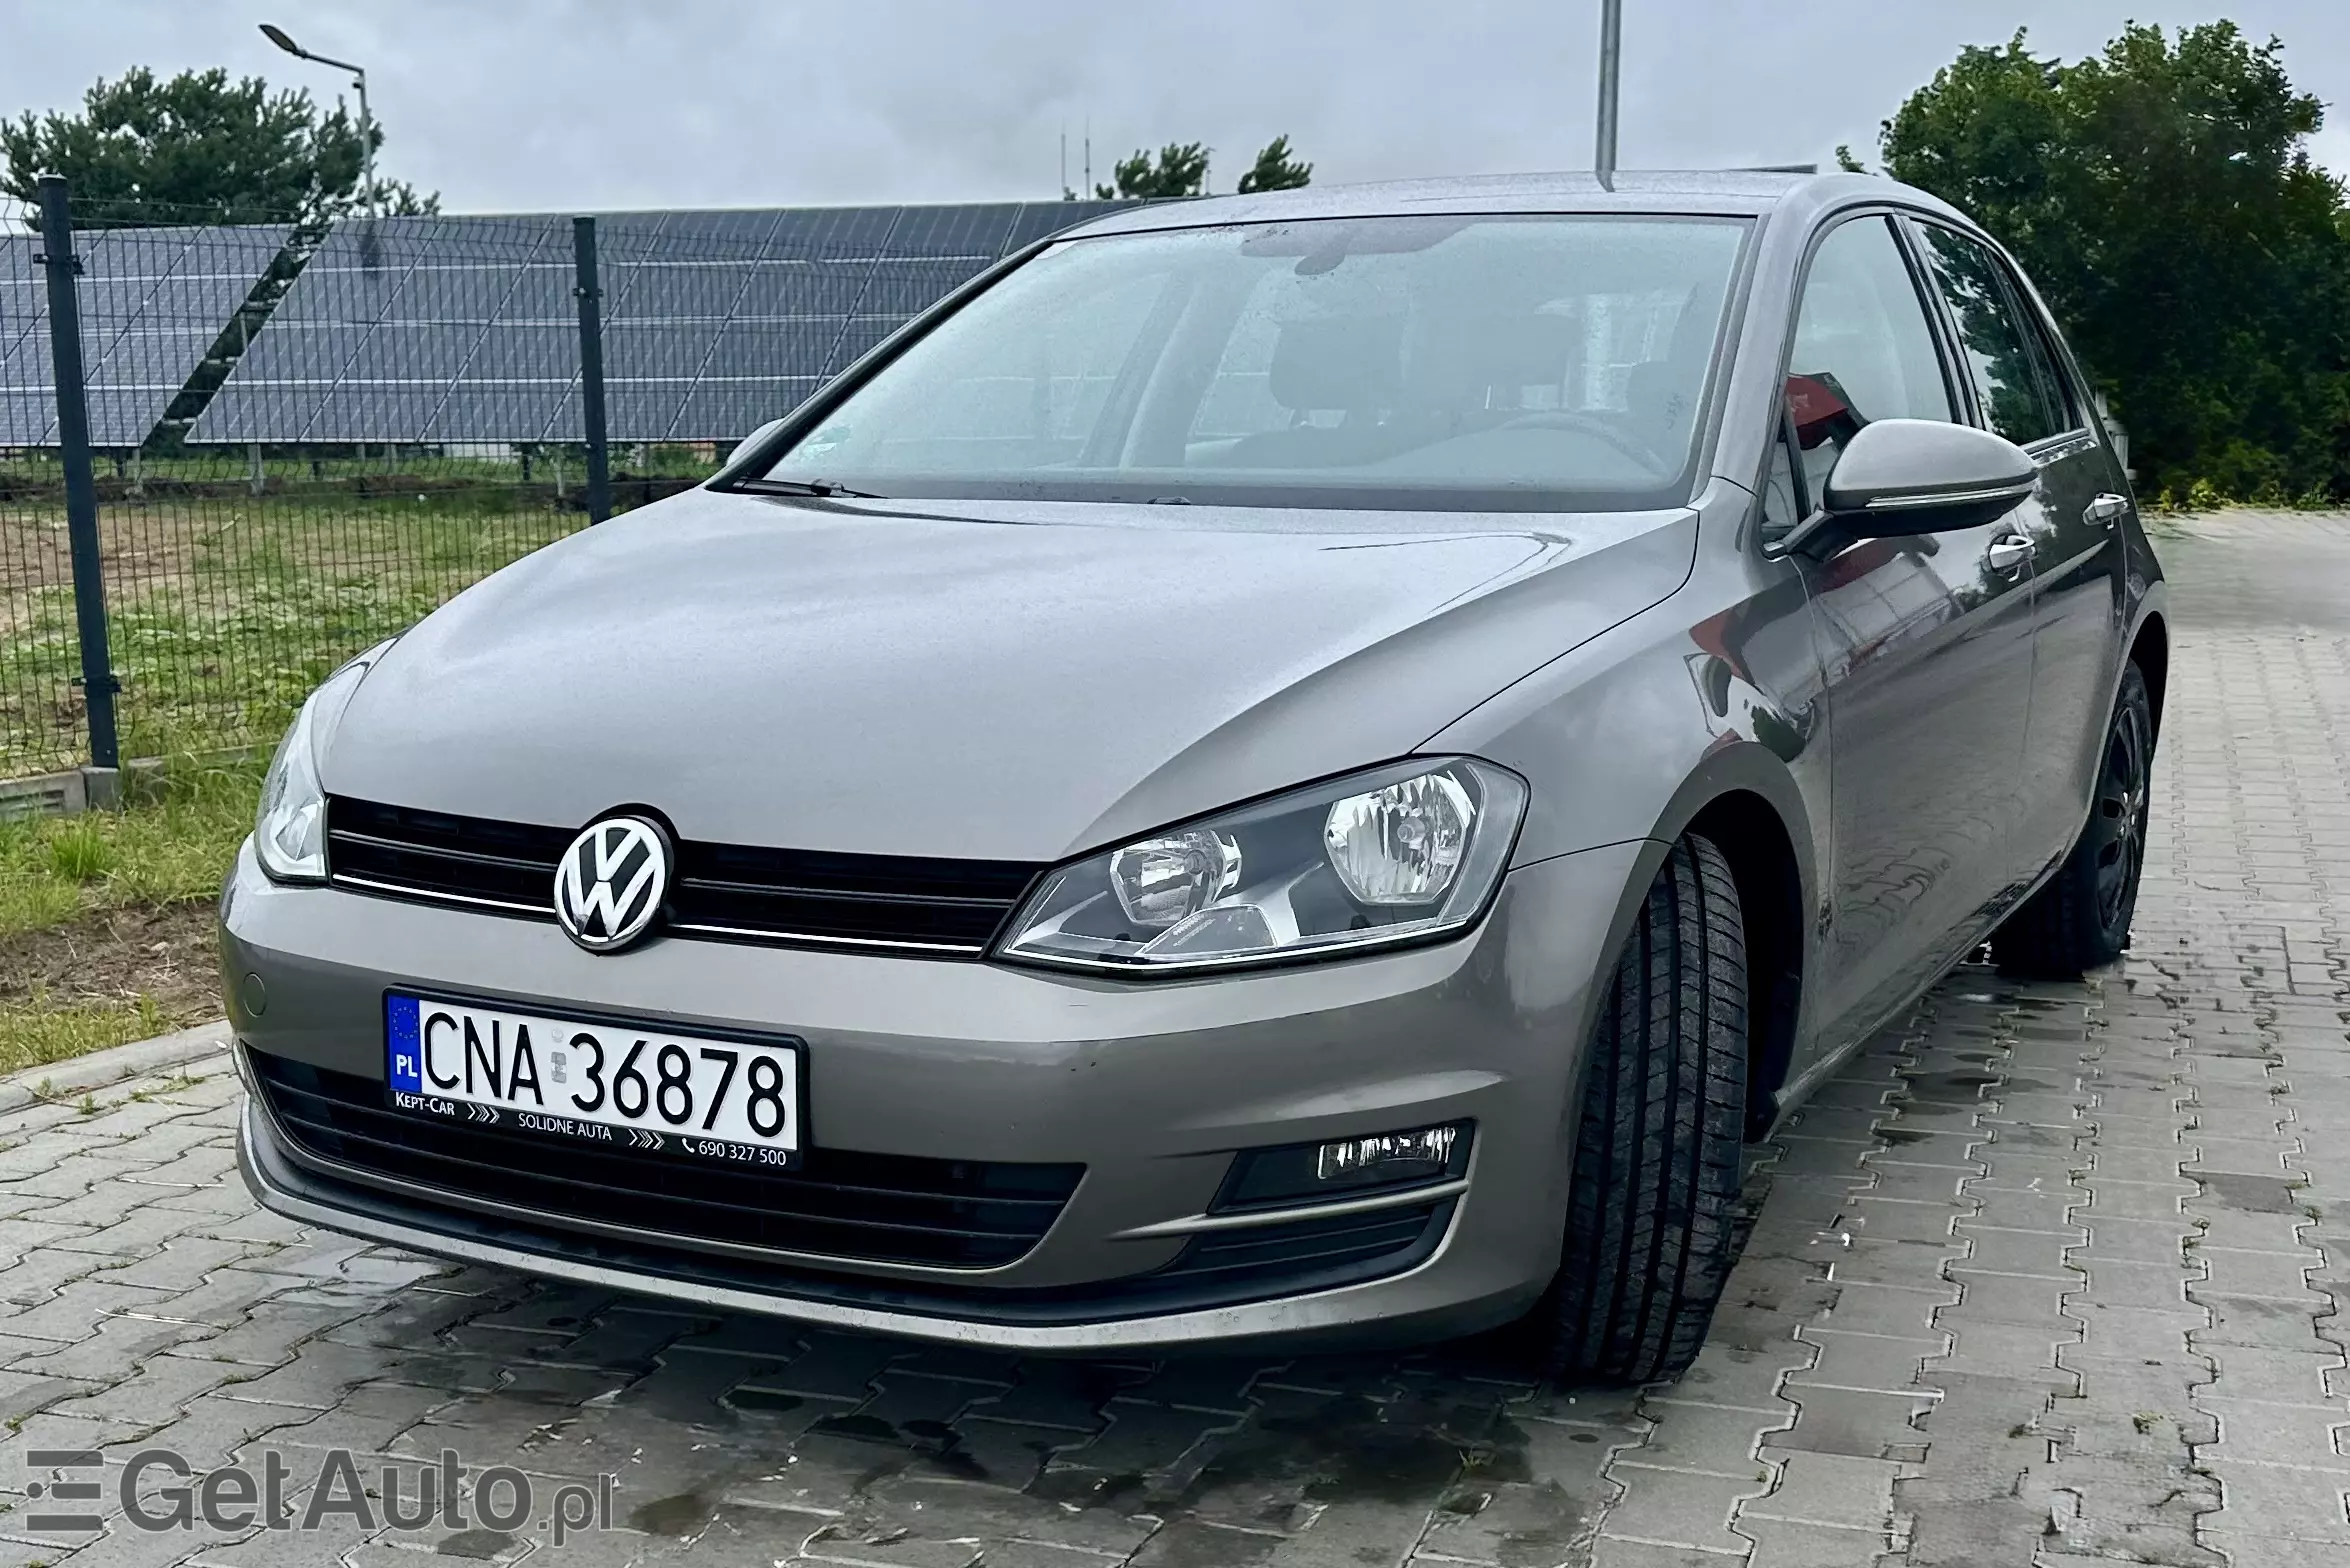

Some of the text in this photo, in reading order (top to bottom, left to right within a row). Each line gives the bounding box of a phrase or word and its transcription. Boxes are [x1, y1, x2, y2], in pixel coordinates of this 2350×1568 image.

[396, 1054, 418, 1079] PL
[424, 1012, 786, 1138] CNA 36878
[518, 1112, 575, 1135] SOLIDNE
[577, 1122, 613, 1141] AUTA
[698, 1140, 725, 1158] 690
[728, 1144, 756, 1161] 327
[759, 1148, 787, 1166] 500
